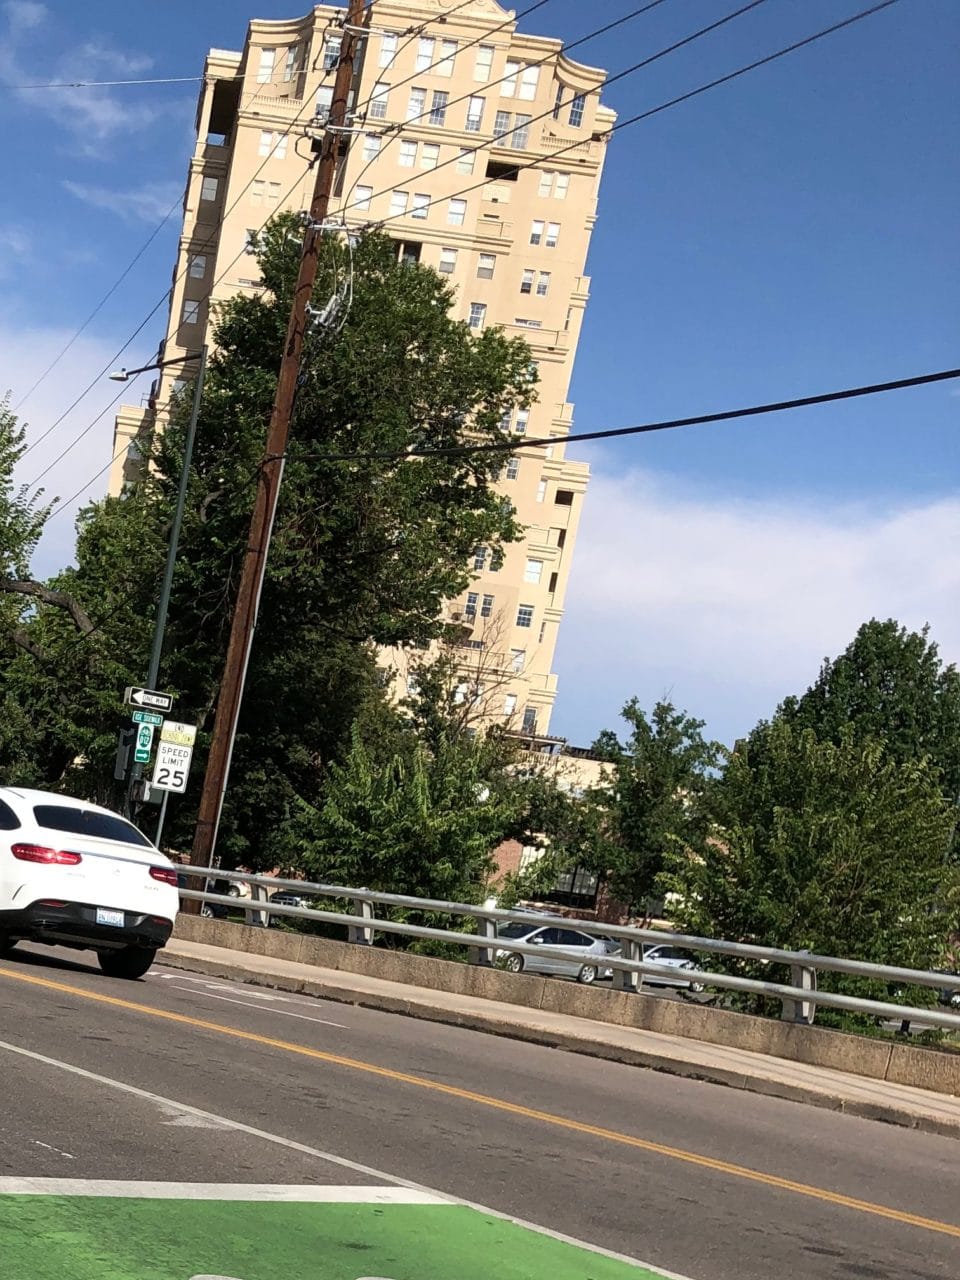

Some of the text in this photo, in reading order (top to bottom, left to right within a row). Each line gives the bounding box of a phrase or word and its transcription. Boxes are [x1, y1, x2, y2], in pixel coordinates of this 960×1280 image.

[142, 694, 167, 704] ONE WAY
[161, 746, 189, 758] SPEED
[162, 758, 184, 767] LIMIT
[157, 768, 185, 787] 25
